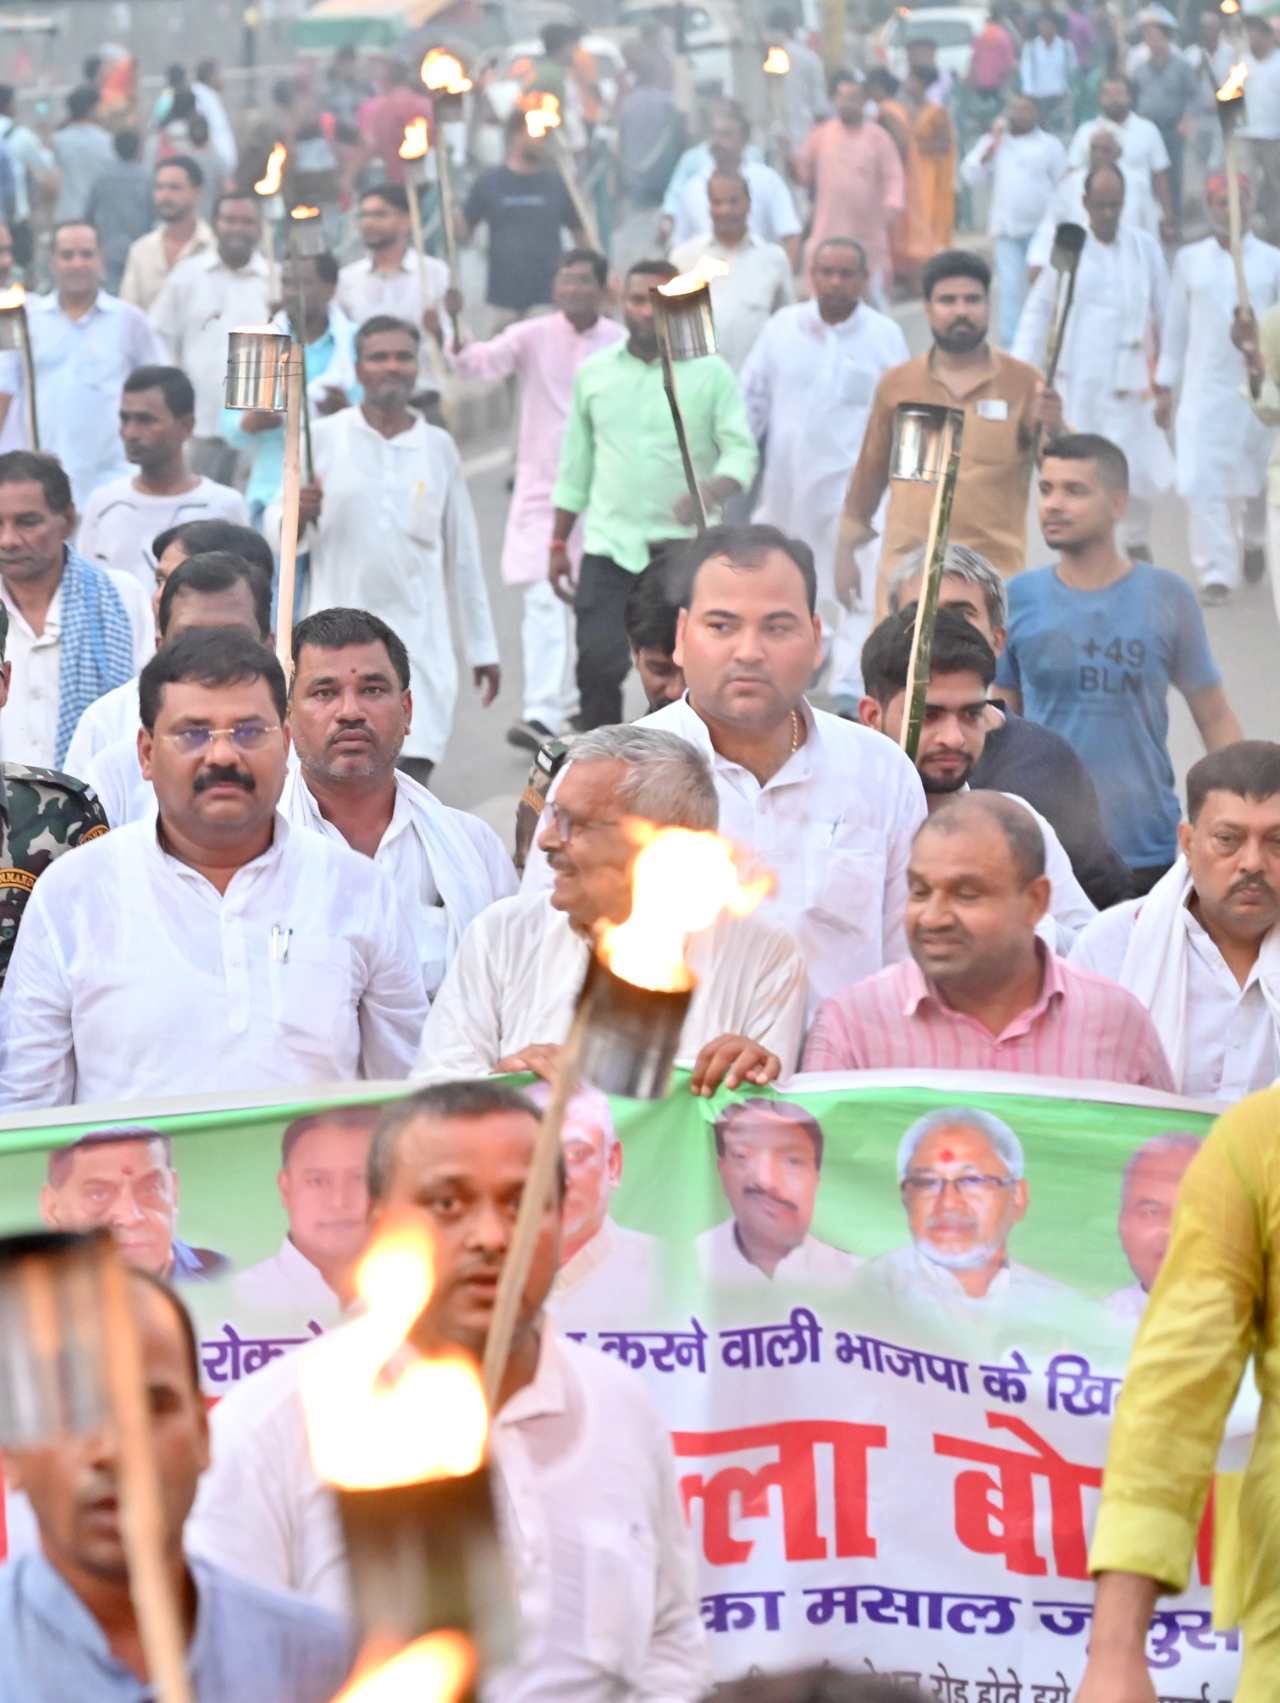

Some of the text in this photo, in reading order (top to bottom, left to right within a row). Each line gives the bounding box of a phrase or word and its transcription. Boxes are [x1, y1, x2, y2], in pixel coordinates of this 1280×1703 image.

[1081, 636, 1146, 668] +49
[719, 1307, 823, 1369] वाली
[835, 1331, 970, 1394] भाजपा
[979, 1350, 1032, 1403] के
[803, 1585, 1022, 1635] मसाल
